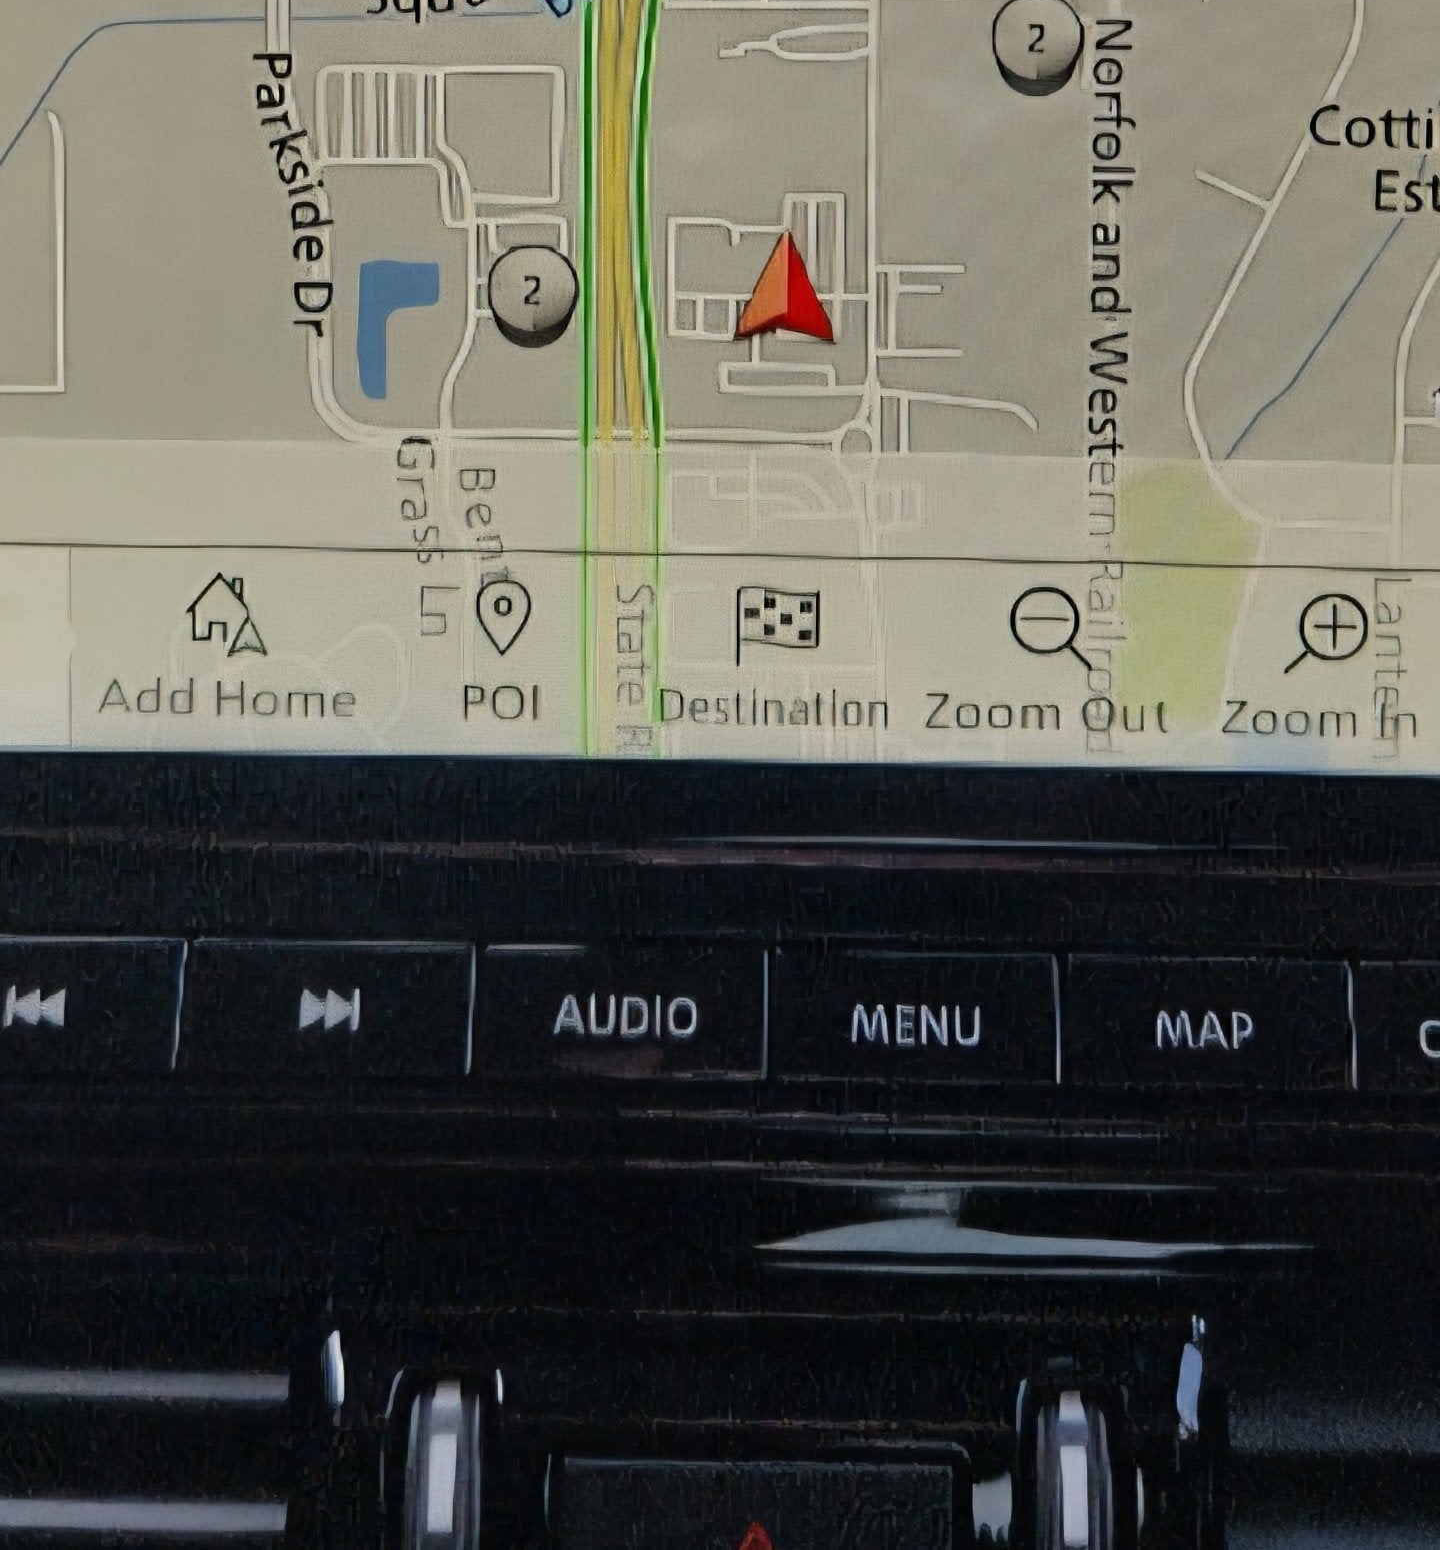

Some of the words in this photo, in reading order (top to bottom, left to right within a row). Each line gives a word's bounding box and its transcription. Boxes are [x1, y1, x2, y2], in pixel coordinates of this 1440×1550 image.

[1027, 22, 1047, 53] 2
[1091, 19, 1137, 206] Norfolk
[252, 52, 335, 264] Parkside
[1090, 221, 1133, 314] and
[293, 280, 334, 339] Dr
[521, 275, 542, 307] 2
[1087, 330, 1129, 538] Western
[98, 677, 196, 718] Add
[214, 679, 358, 720] Home
[464, 684, 539, 721] POI
[659, 687, 889, 731] Destination
[925, 692, 1061, 731] Zoom
[1081, 696, 1170, 734] Out
[1221, 699, 1358, 738] Zoom
[1379, 701, 1417, 739] In
[552, 992, 698, 1040] AUDIO
[849, 1002, 982, 1050] MENU
[1154, 1008, 1257, 1052] MAP
